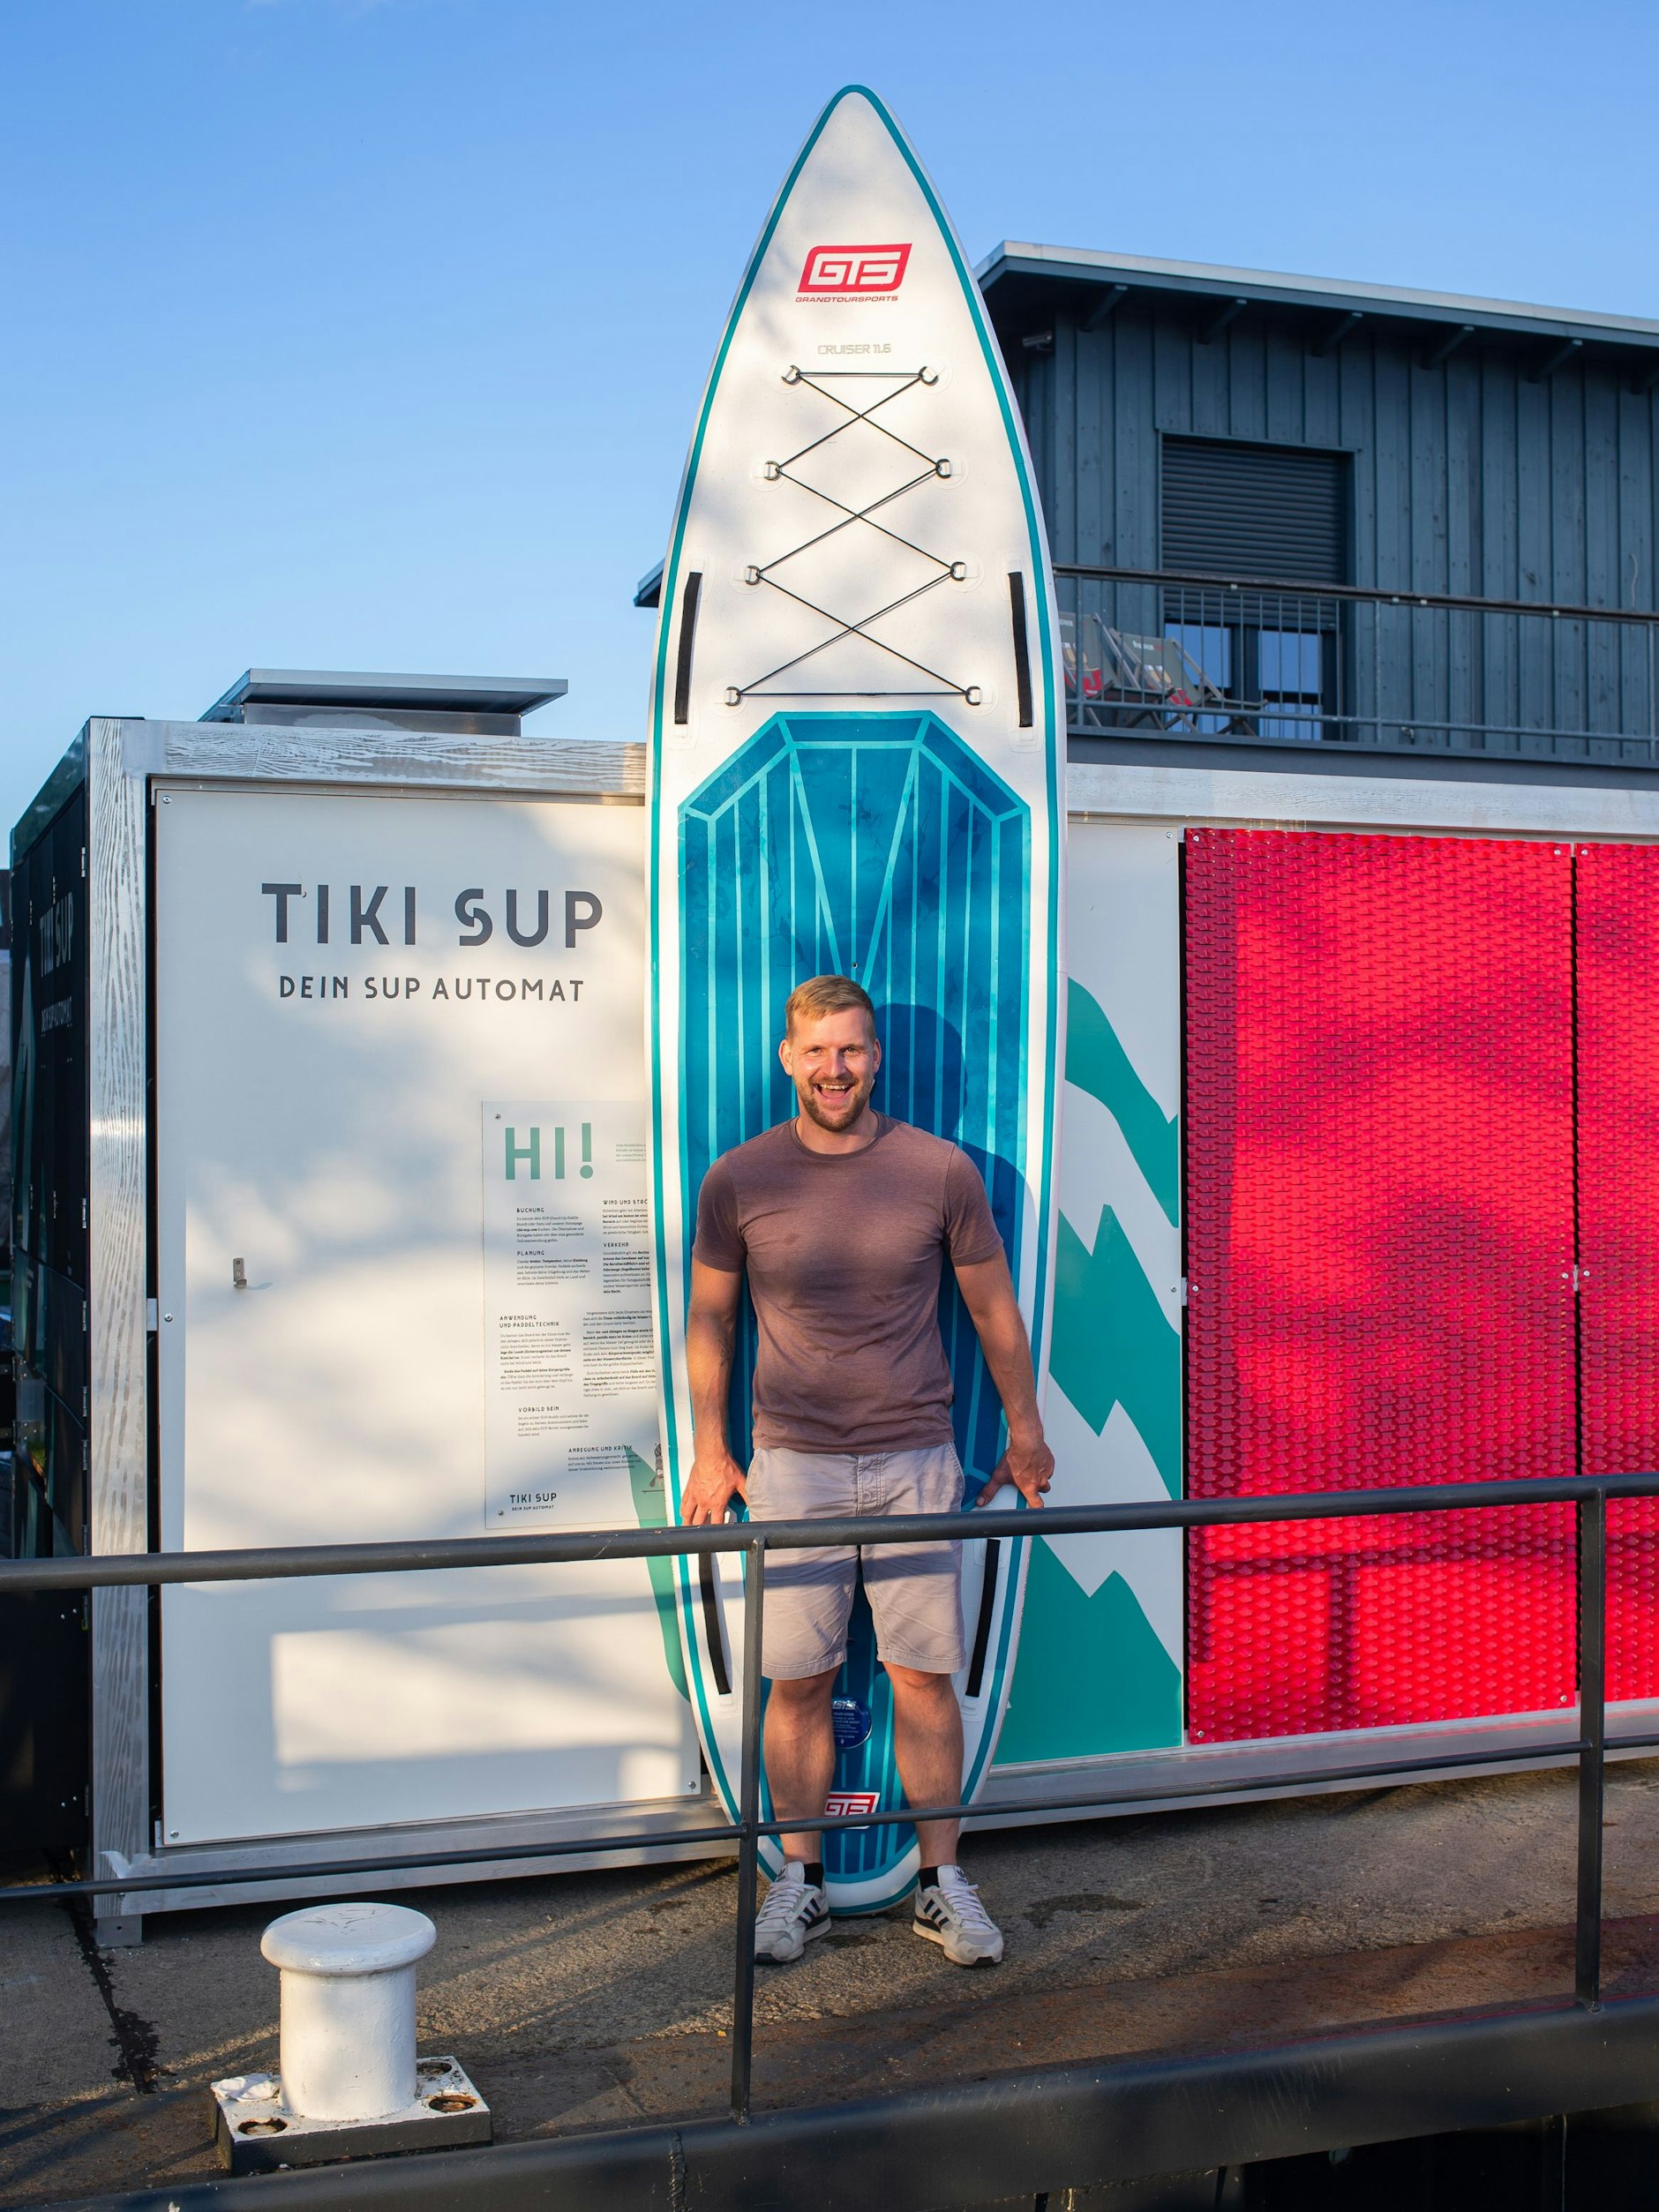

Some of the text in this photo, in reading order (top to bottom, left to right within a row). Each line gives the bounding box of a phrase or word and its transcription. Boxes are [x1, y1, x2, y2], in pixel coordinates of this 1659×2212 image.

[807, 251, 903, 286] GTS
[817, 343, 891, 355] CRUISER 11.6
[55, 891, 73, 968] SUP
[261, 883, 603, 949] TIKI SUP
[280, 976, 584, 1001] DEIN SUP AUTOMAT
[505, 1122, 594, 1181] HI!
[509, 1493, 557, 1503] TIKI SUP
